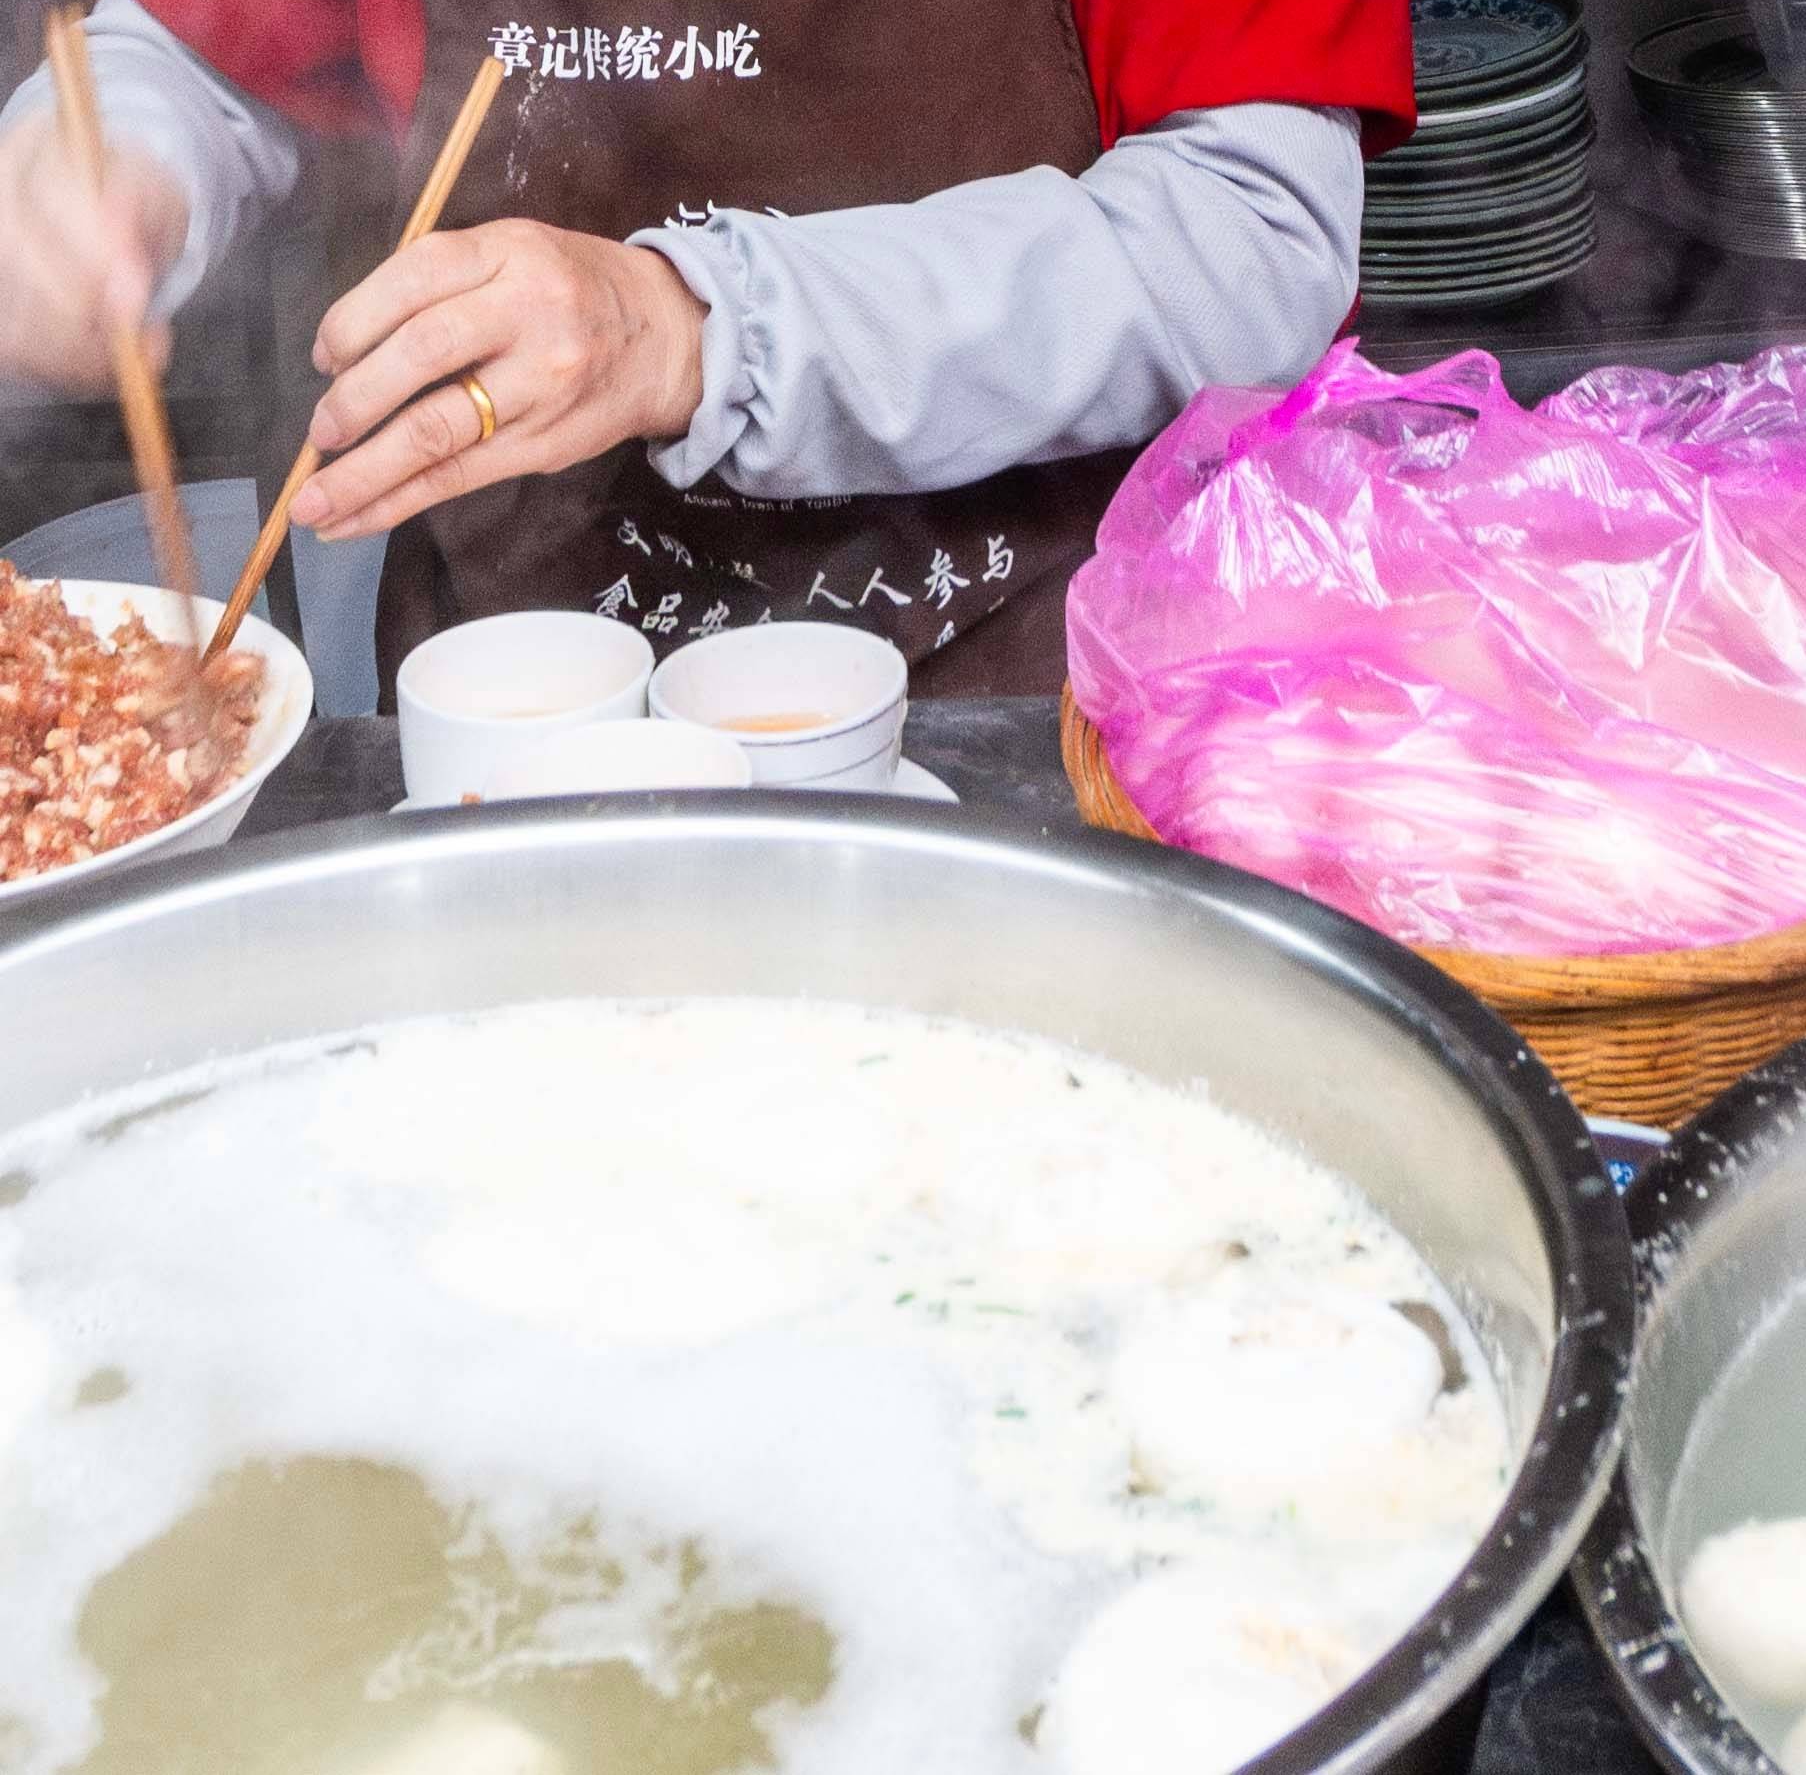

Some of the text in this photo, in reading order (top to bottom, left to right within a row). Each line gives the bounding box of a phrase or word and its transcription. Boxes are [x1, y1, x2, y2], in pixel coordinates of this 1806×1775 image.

[487, 21, 763, 81] 章记传统小吃
